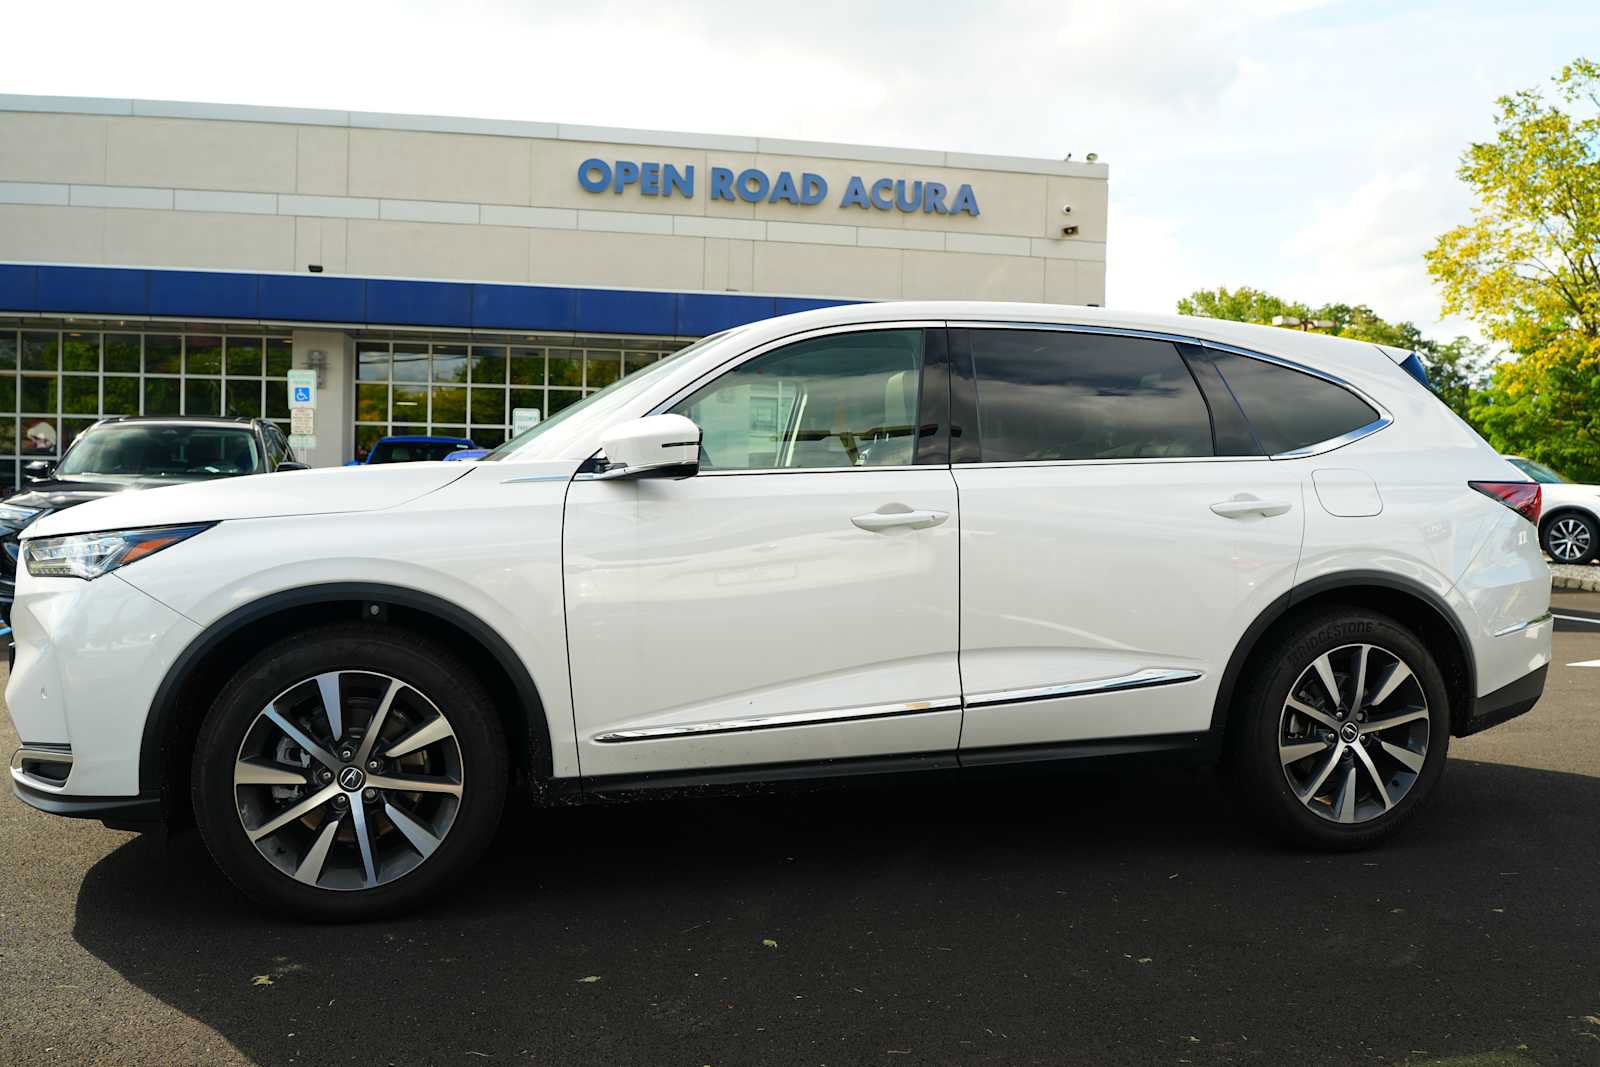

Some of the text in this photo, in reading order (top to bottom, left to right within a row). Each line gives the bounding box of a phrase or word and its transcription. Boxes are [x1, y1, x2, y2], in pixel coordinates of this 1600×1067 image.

[577, 158, 980, 216] OPEN ROAD ACURA
